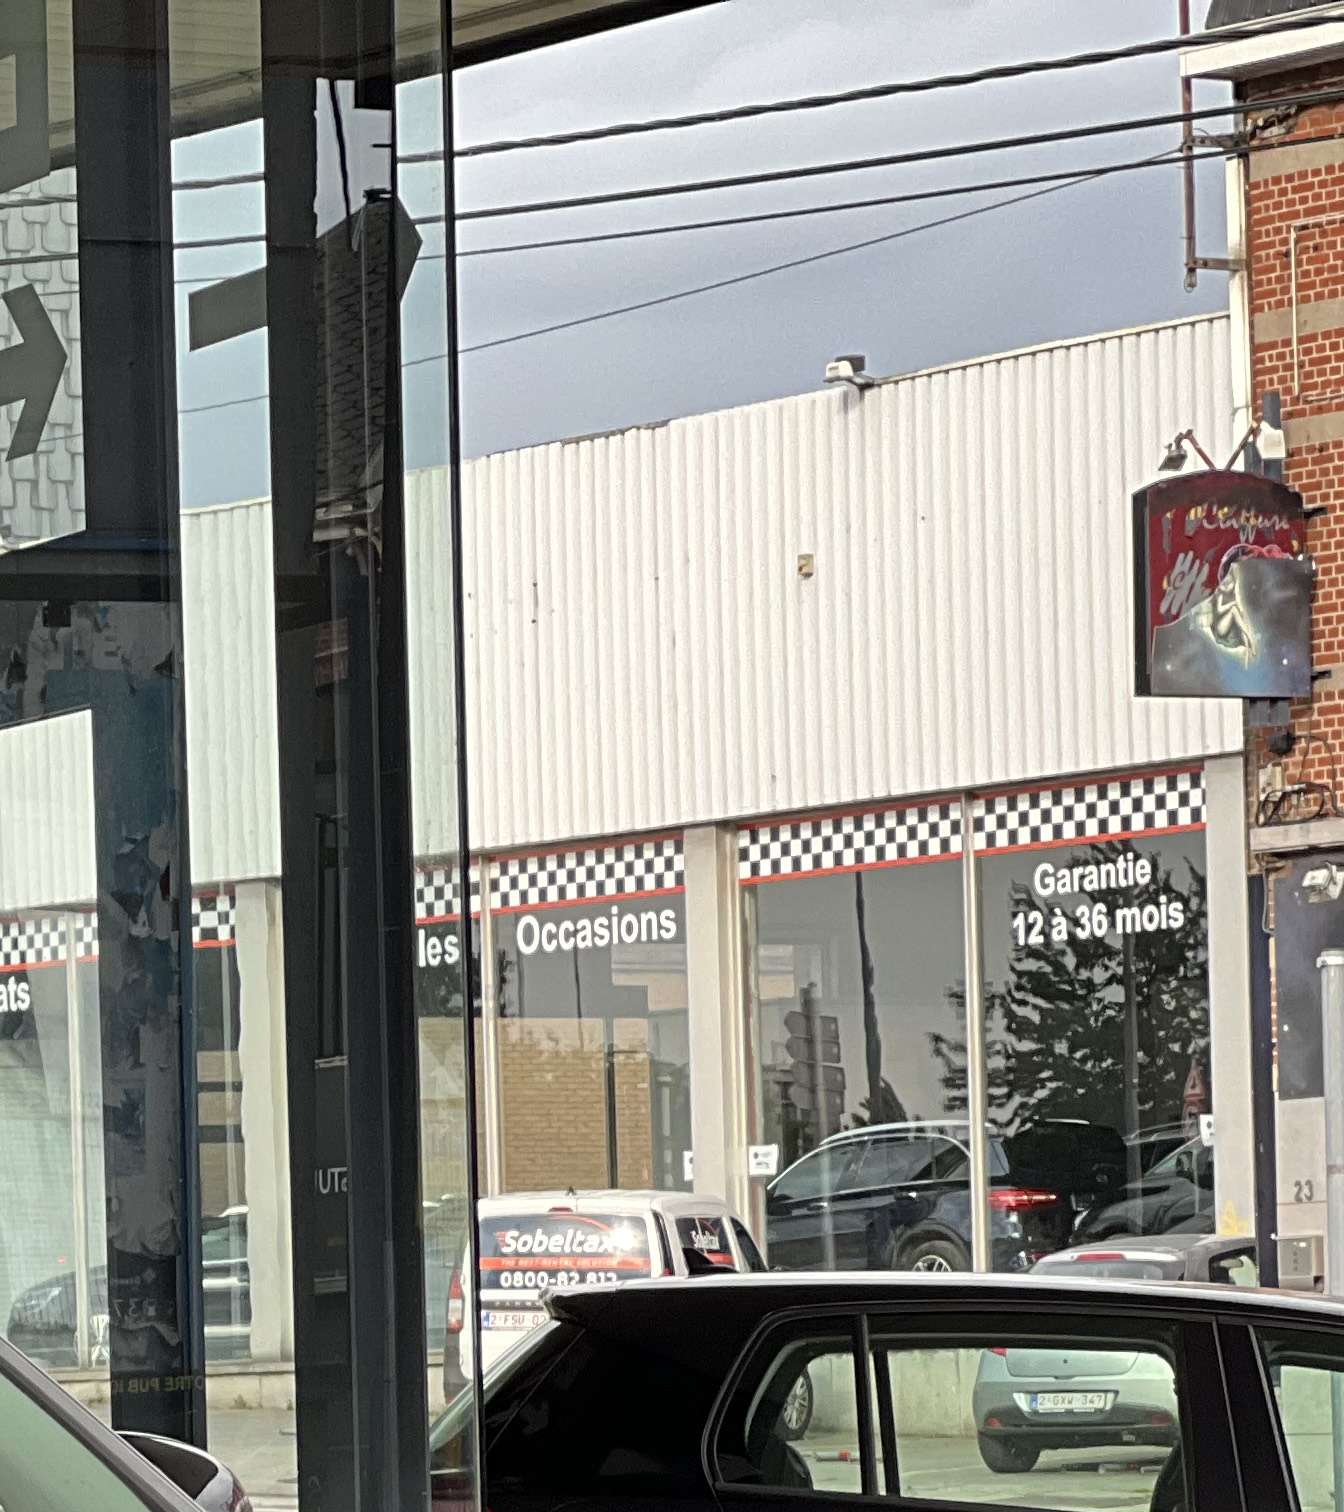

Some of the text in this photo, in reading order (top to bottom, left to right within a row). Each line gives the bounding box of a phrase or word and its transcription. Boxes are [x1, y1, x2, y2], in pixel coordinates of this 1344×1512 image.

[1033, 853, 1153, 899] Garantie
[516, 906, 678, 956] Occasions
[1012, 895, 1186, 948] 12 à 36 mois
[1293, 1179, 1315, 1204] 23
[501, 1227, 613, 1255] Sobeltax
